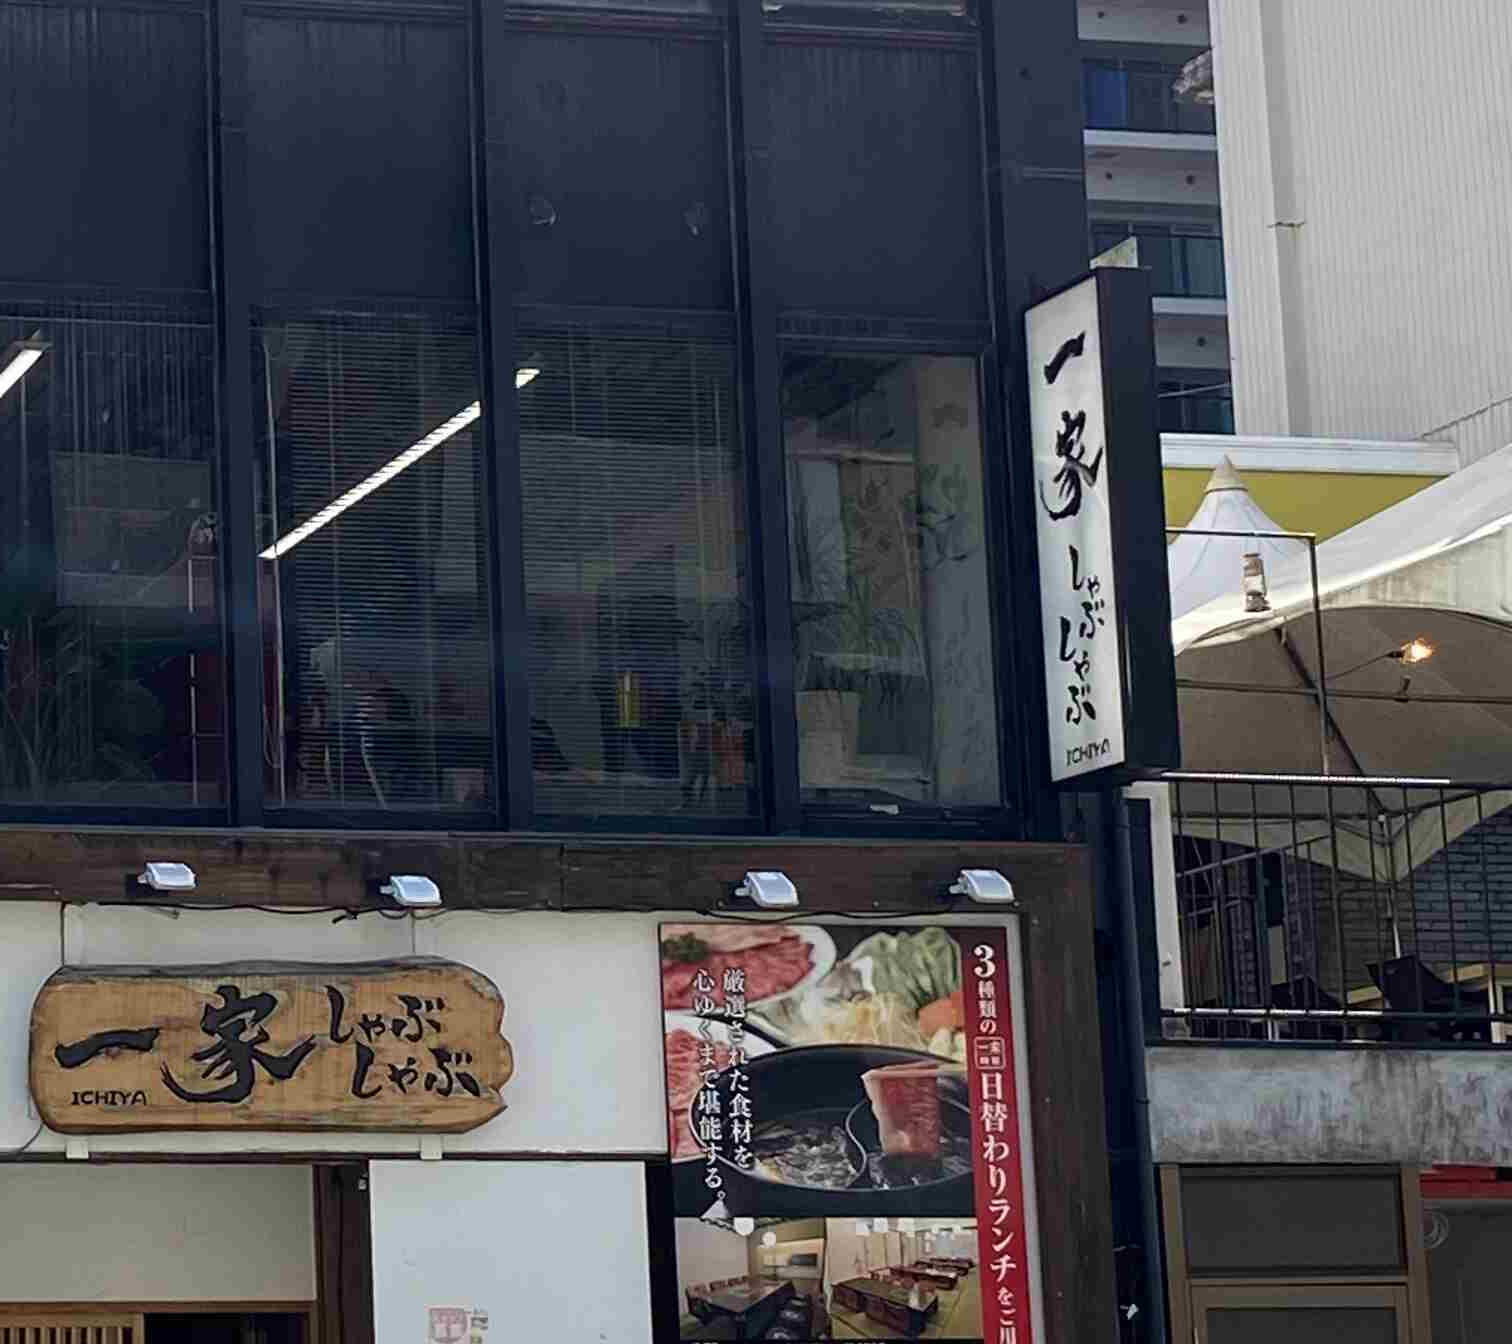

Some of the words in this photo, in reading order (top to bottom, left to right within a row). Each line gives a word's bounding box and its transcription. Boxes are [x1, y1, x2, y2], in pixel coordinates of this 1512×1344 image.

[1065, 738, 1112, 767] ICHIYA
[324, 984, 447, 1044] しゃぶ
[54, 984, 317, 1104] 一家
[351, 1044, 482, 1099] しゃぶ
[71, 1089, 147, 1107] ICHIYA
